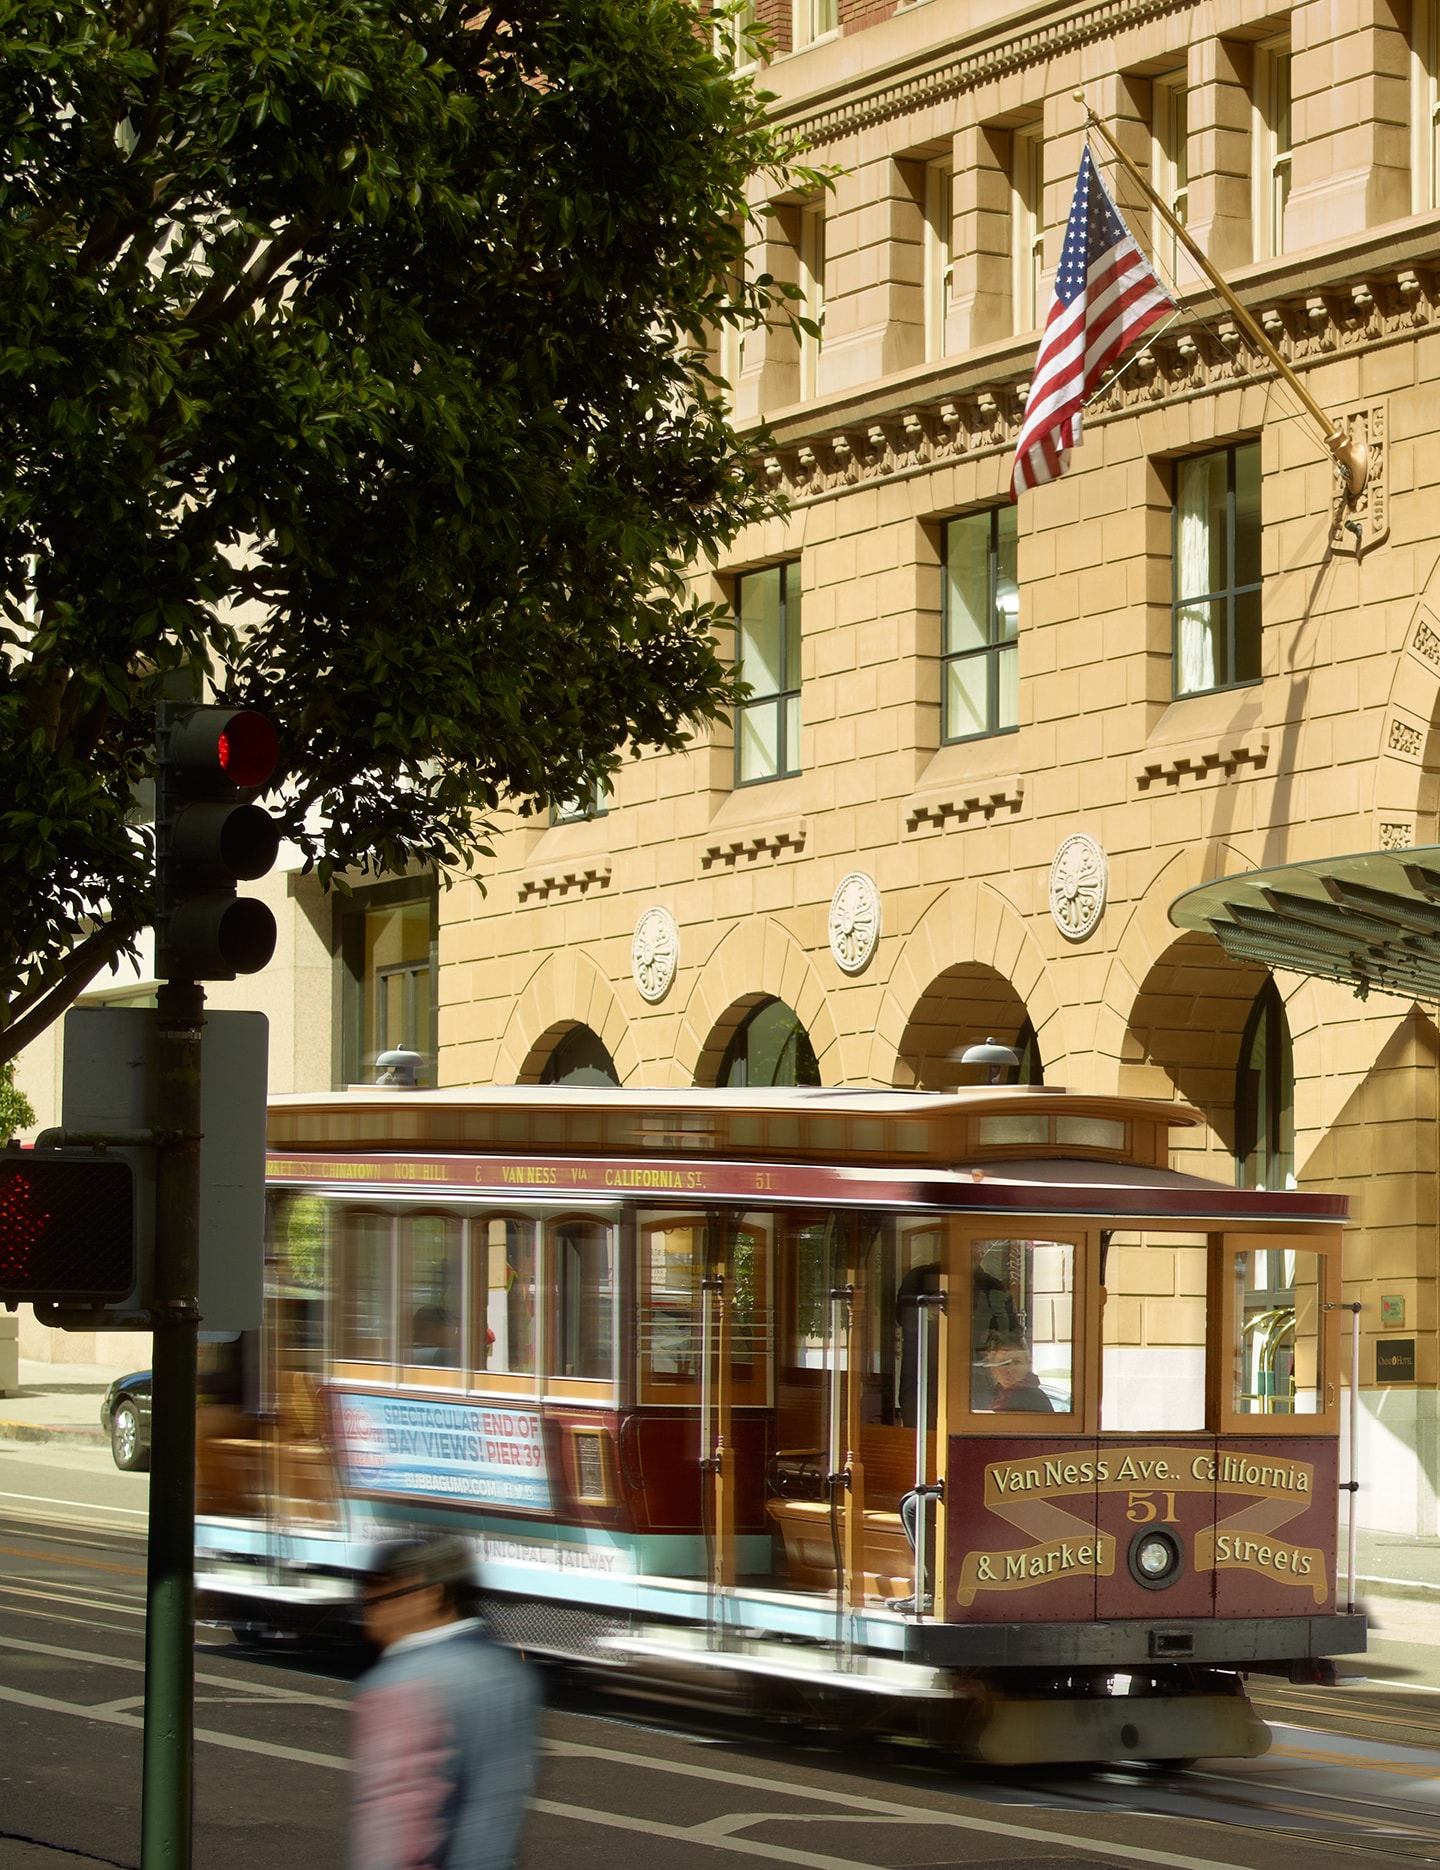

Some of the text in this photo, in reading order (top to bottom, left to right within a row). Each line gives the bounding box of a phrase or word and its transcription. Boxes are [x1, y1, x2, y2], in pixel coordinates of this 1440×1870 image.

[321, 1162, 381, 1180] CHINATOWN
[395, 1163, 416, 1180] NOB
[424, 1164, 449, 1182] HILL
[502, 1166, 525, 1184] VAN
[527, 1167, 557, 1184] NESS
[605, 1169, 683, 1189] CALIFORNIA
[755, 1172, 773, 1191] 51
[384, 1404, 481, 1433] SPECTACULAR
[482, 1412, 539, 1439] END OF
[386, 1428, 418, 1455] BAY
[421, 1431, 485, 1463] VIEWS!
[486, 1440, 541, 1467] PIER 39
[404, 1472, 497, 1497] BUBBAGUMP.COM
[992, 1465, 1041, 1495] Van
[1044, 1459, 1110, 1489] Ness
[1191, 1455, 1309, 1493] California
[1126, 1492, 1181, 1523] 51
[555, 1549, 614, 1572] RAILWAY
[976, 1539, 1105, 1582] & Market
[1215, 1534, 1314, 1576] Streets
